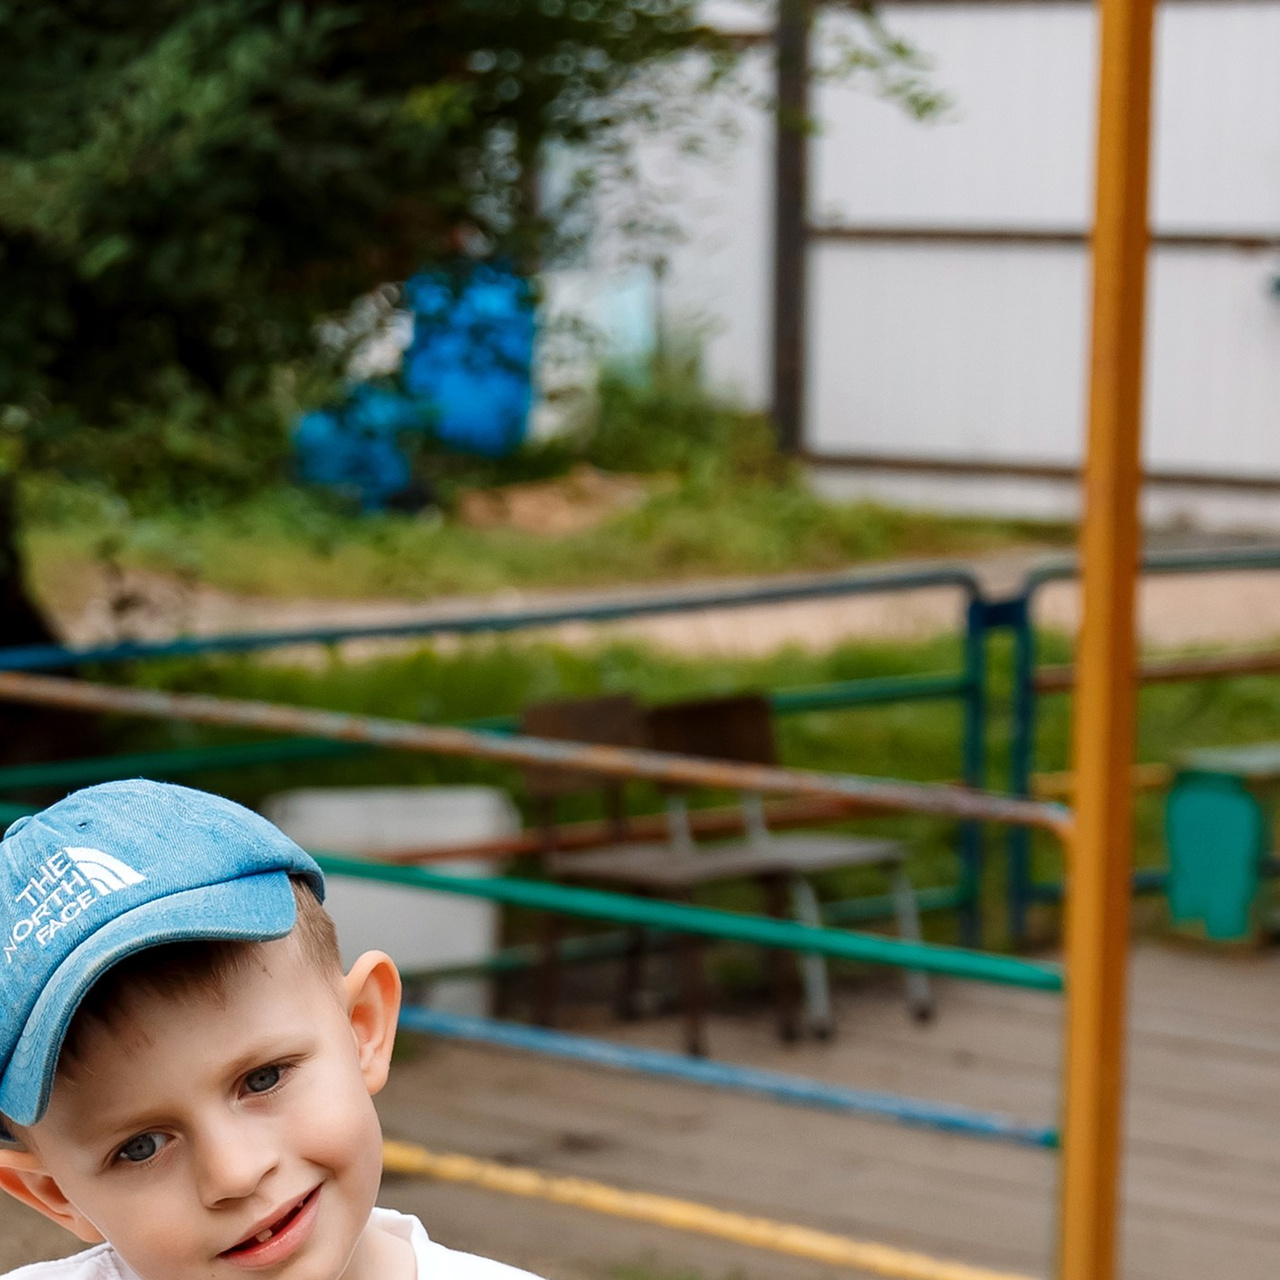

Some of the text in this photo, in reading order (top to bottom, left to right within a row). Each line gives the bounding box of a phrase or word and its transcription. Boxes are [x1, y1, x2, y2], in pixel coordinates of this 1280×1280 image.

[15, 851, 73, 907] THE
[3, 869, 87, 964] NORTH
[35, 888, 98, 946] FACE
